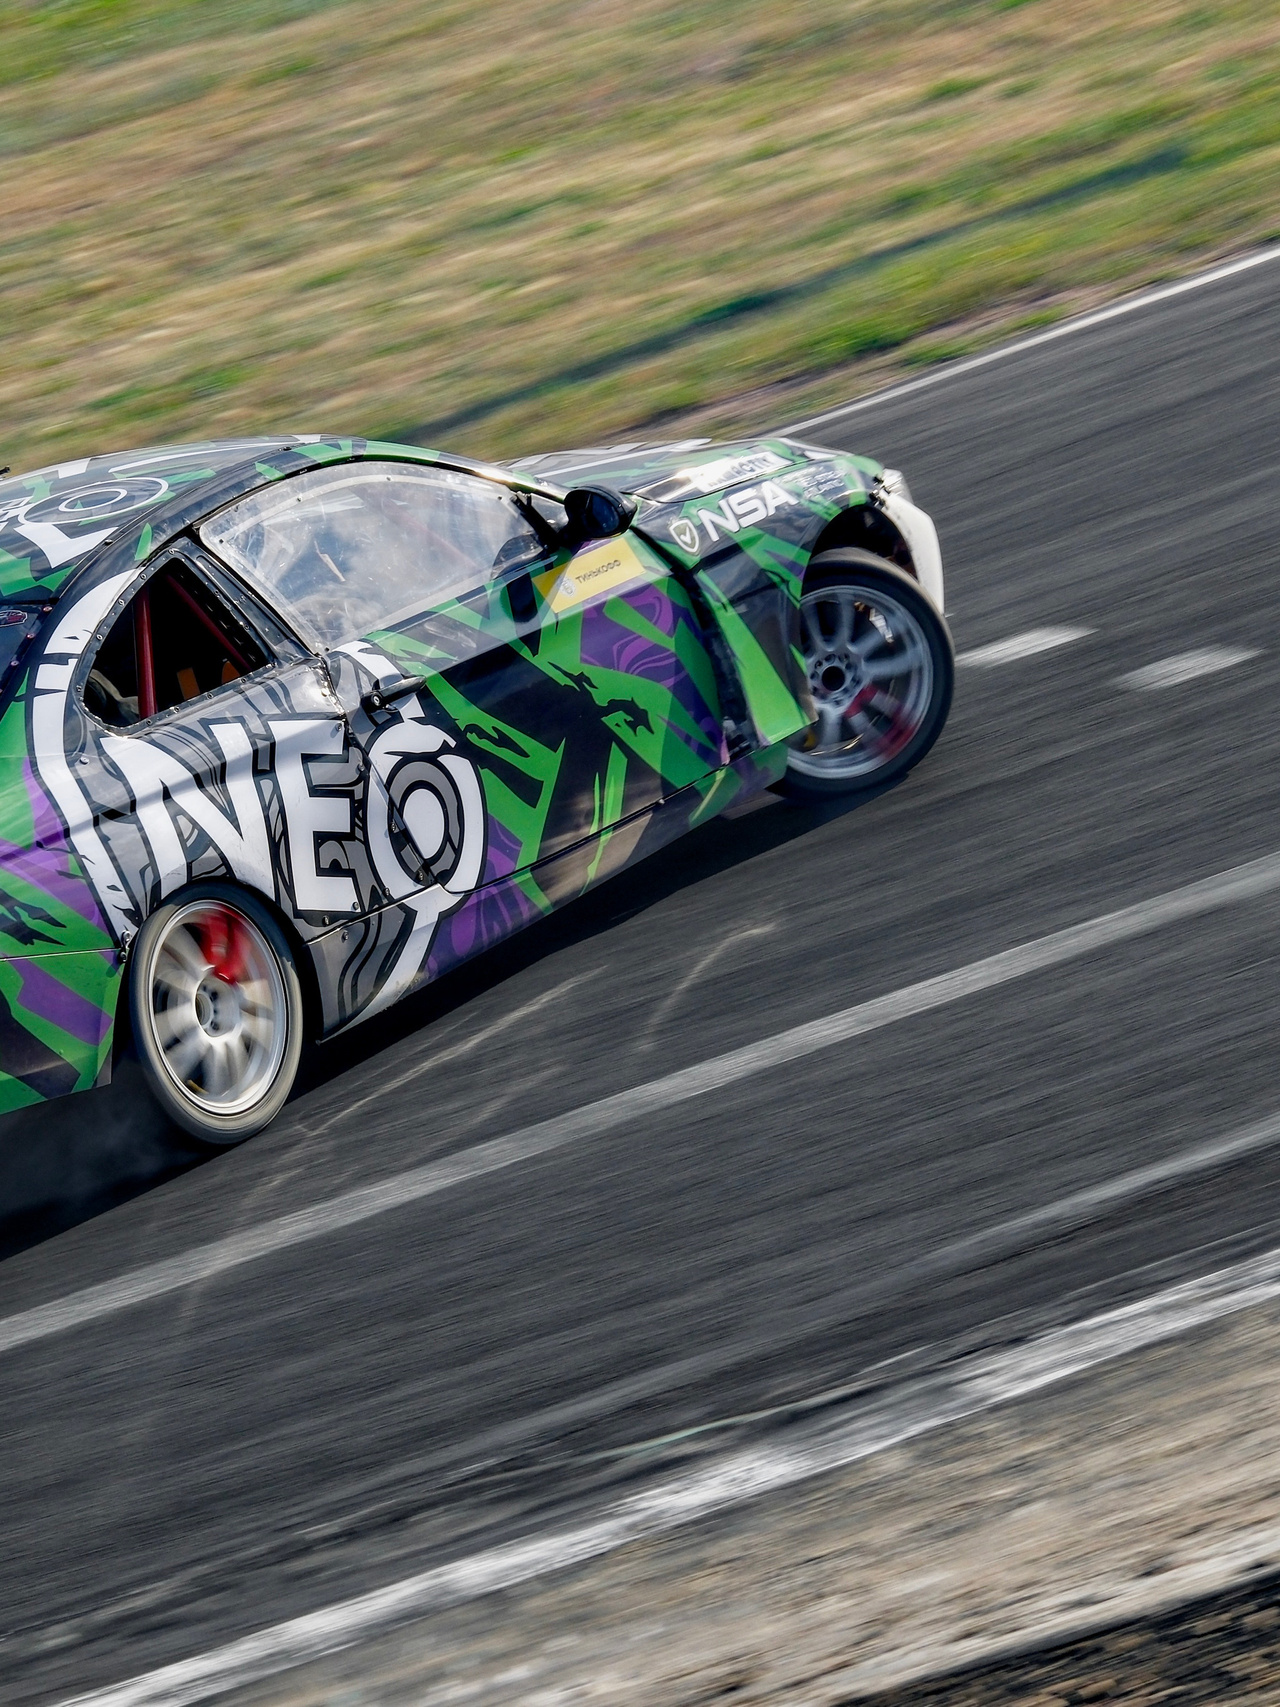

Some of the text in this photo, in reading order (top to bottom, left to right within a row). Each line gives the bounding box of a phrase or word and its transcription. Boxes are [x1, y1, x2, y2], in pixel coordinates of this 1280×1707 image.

[697, 480, 800, 542] NSA
[575, 560, 622, 584] ТИНЬКОФФ
[99, 714, 487, 911] NEO
